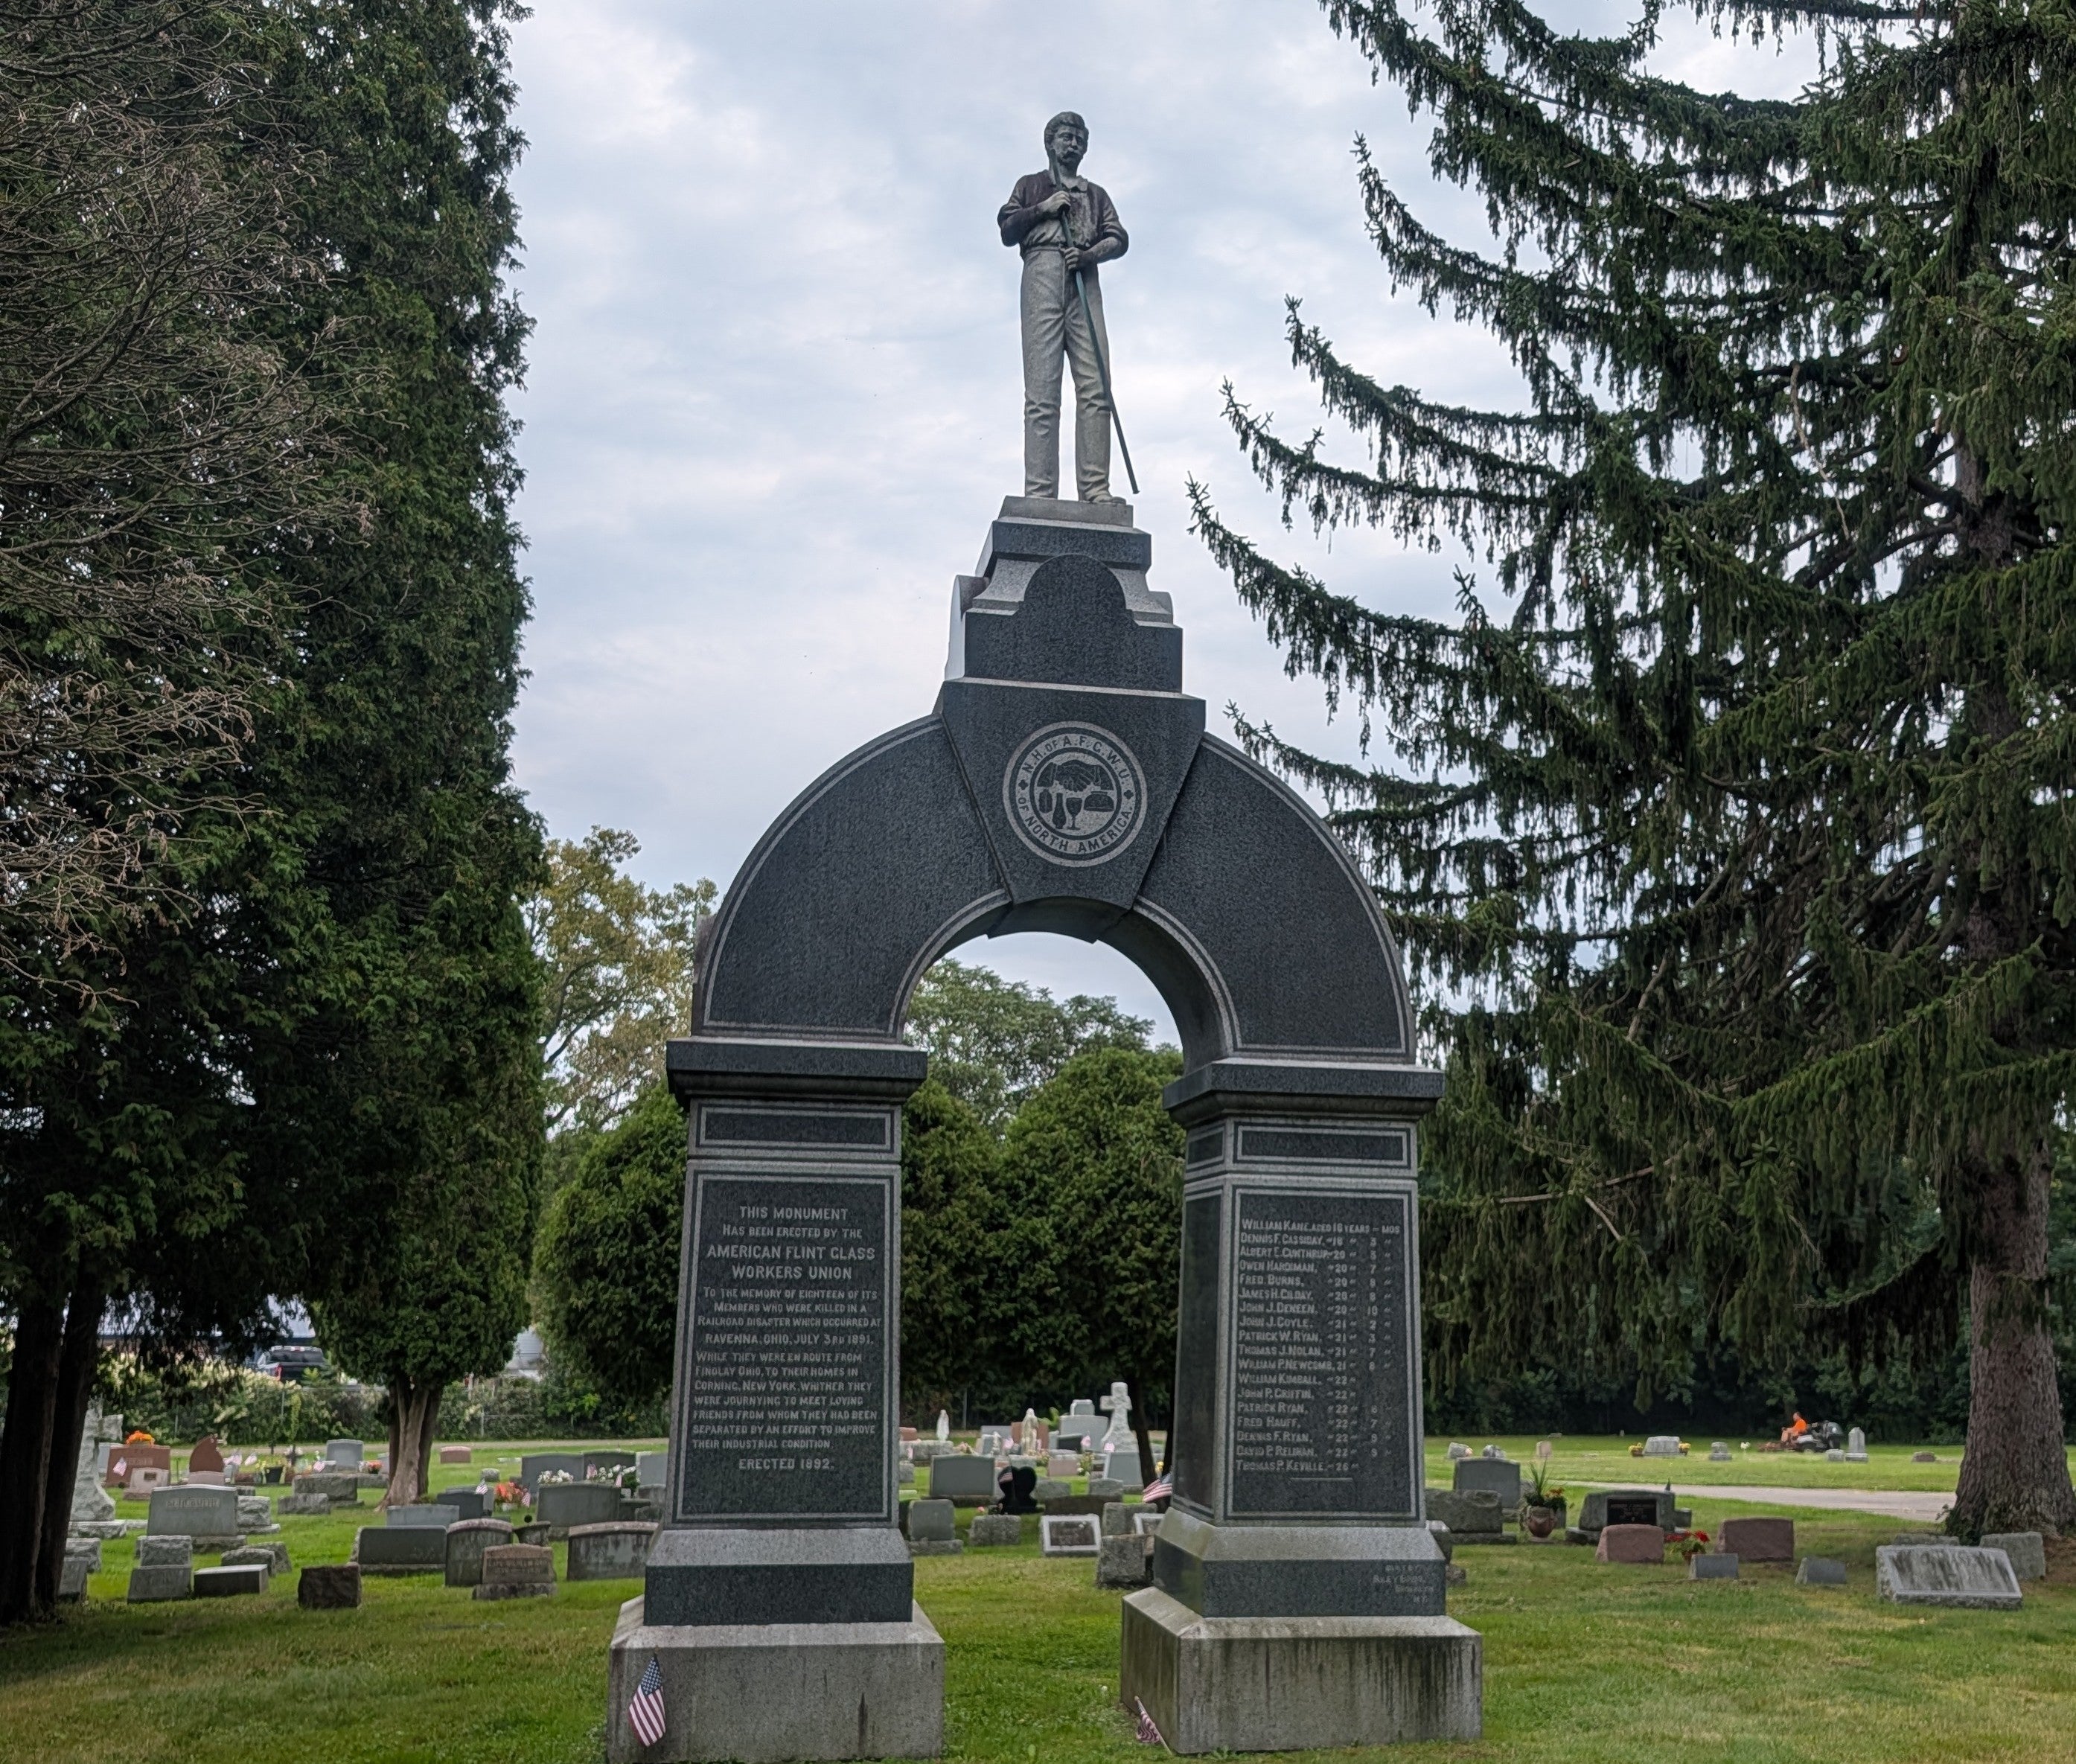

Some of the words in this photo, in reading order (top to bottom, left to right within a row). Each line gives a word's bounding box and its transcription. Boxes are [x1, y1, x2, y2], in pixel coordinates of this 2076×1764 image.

[1045, 740, 1059, 752] OF
[1018, 796, 1029, 812] OF
[1024, 817, 1069, 851] NORTH
[1079, 807, 1133, 853] AMERICA.
[740, 1205, 767, 1218] THIS
[774, 1207, 848, 1221] MONUMENT
[723, 1224, 744, 1236] HAS
[749, 1227, 773, 1236] BEEN
[777, 1227, 820, 1239] ERECTED
[824, 1228, 838, 1237] BY
[842, 1228, 862, 1239] THE
[706, 1244, 781, 1259] AMERICAN
[786, 1246, 826, 1259] FLINT
[830, 1247, 875, 1260] GLASS
[732, 1263, 802, 1279] WORKERS
[808, 1267, 852, 1279] UNION
[703, 1287, 715, 1297] TO
[721, 1288, 738, 1298] THE
[741, 1289, 782, 1299] MEMORY
[785, 1290, 796, 1299] OF
[799, 1290, 845, 1299] EIGHTEEN
[848, 1291, 859, 1300] OF
[861, 1291, 878, 1300] ITS
[715, 1302, 760, 1311] MEMBERS
[762, 1303, 783, 1313] WHO
[786, 1303, 812, 1313] WERE
[815, 1304, 846, 1313] KILLED
[849, 1304, 857, 1313] IN
[860, 1305, 867, 1313] A
[697, 1315, 744, 1326] RAILROAD
[747, 1317, 790, 1326] DISASTER
[793, 1317, 821, 1326] WHICH
[823, 1318, 869, 1327] OCCURRED
[870, 1318, 881, 1327] AT
[793, 1334, 820, 1345] JULY
[824, 1333, 845, 1346] 3RD
[1238, 1343, 1277, 1355] THOMAS
[696, 1351, 727, 1363] WHILE
[732, 1352, 756, 1363] THEY
[759, 1352, 785, 1363] WERE
[788, 1353, 801, 1362] EN
[803, 1353, 832, 1363] ROUTE
[835, 1353, 862, 1364] FROM
[696, 1366, 735, 1376] FINDLAY
[765, 1367, 779, 1377] TO
[781, 1367, 809, 1377] THEIR
[811, 1367, 845, 1378] HOMES
[848, 1368, 858, 1376] IN
[743, 1381, 766, 1392] NEW
[800, 1381, 845, 1391] WHITHER
[848, 1382, 872, 1392] THEY
[694, 1396, 721, 1406] WERE
[783, 1396, 796, 1407] TO
[799, 1396, 827, 1406] MEET
[829, 1396, 863, 1406] LOVING
[693, 1410, 734, 1420] FRIENDS
[737, 1410, 764, 1420] FROM
[767, 1410, 799, 1420] WHOM
[802, 1410, 828, 1421] THEY
[830, 1410, 849, 1420] HAD
[851, 1410, 878, 1420] BEEN
[692, 1425, 747, 1434] SEPARATED
[750, 1425, 764, 1435] BY
[765, 1425, 779, 1434] AN
[782, 1425, 817, 1436] EFFORT
[820, 1425, 833, 1436] TO
[834, 1425, 876, 1435] IMPROVE
[692, 1439, 720, 1449] THEIR
[722, 1439, 779, 1450] INDUSTRIAL
[738, 1459, 795, 1470] ERECTED
[1236, 1460, 1276, 1471] THOMAS
